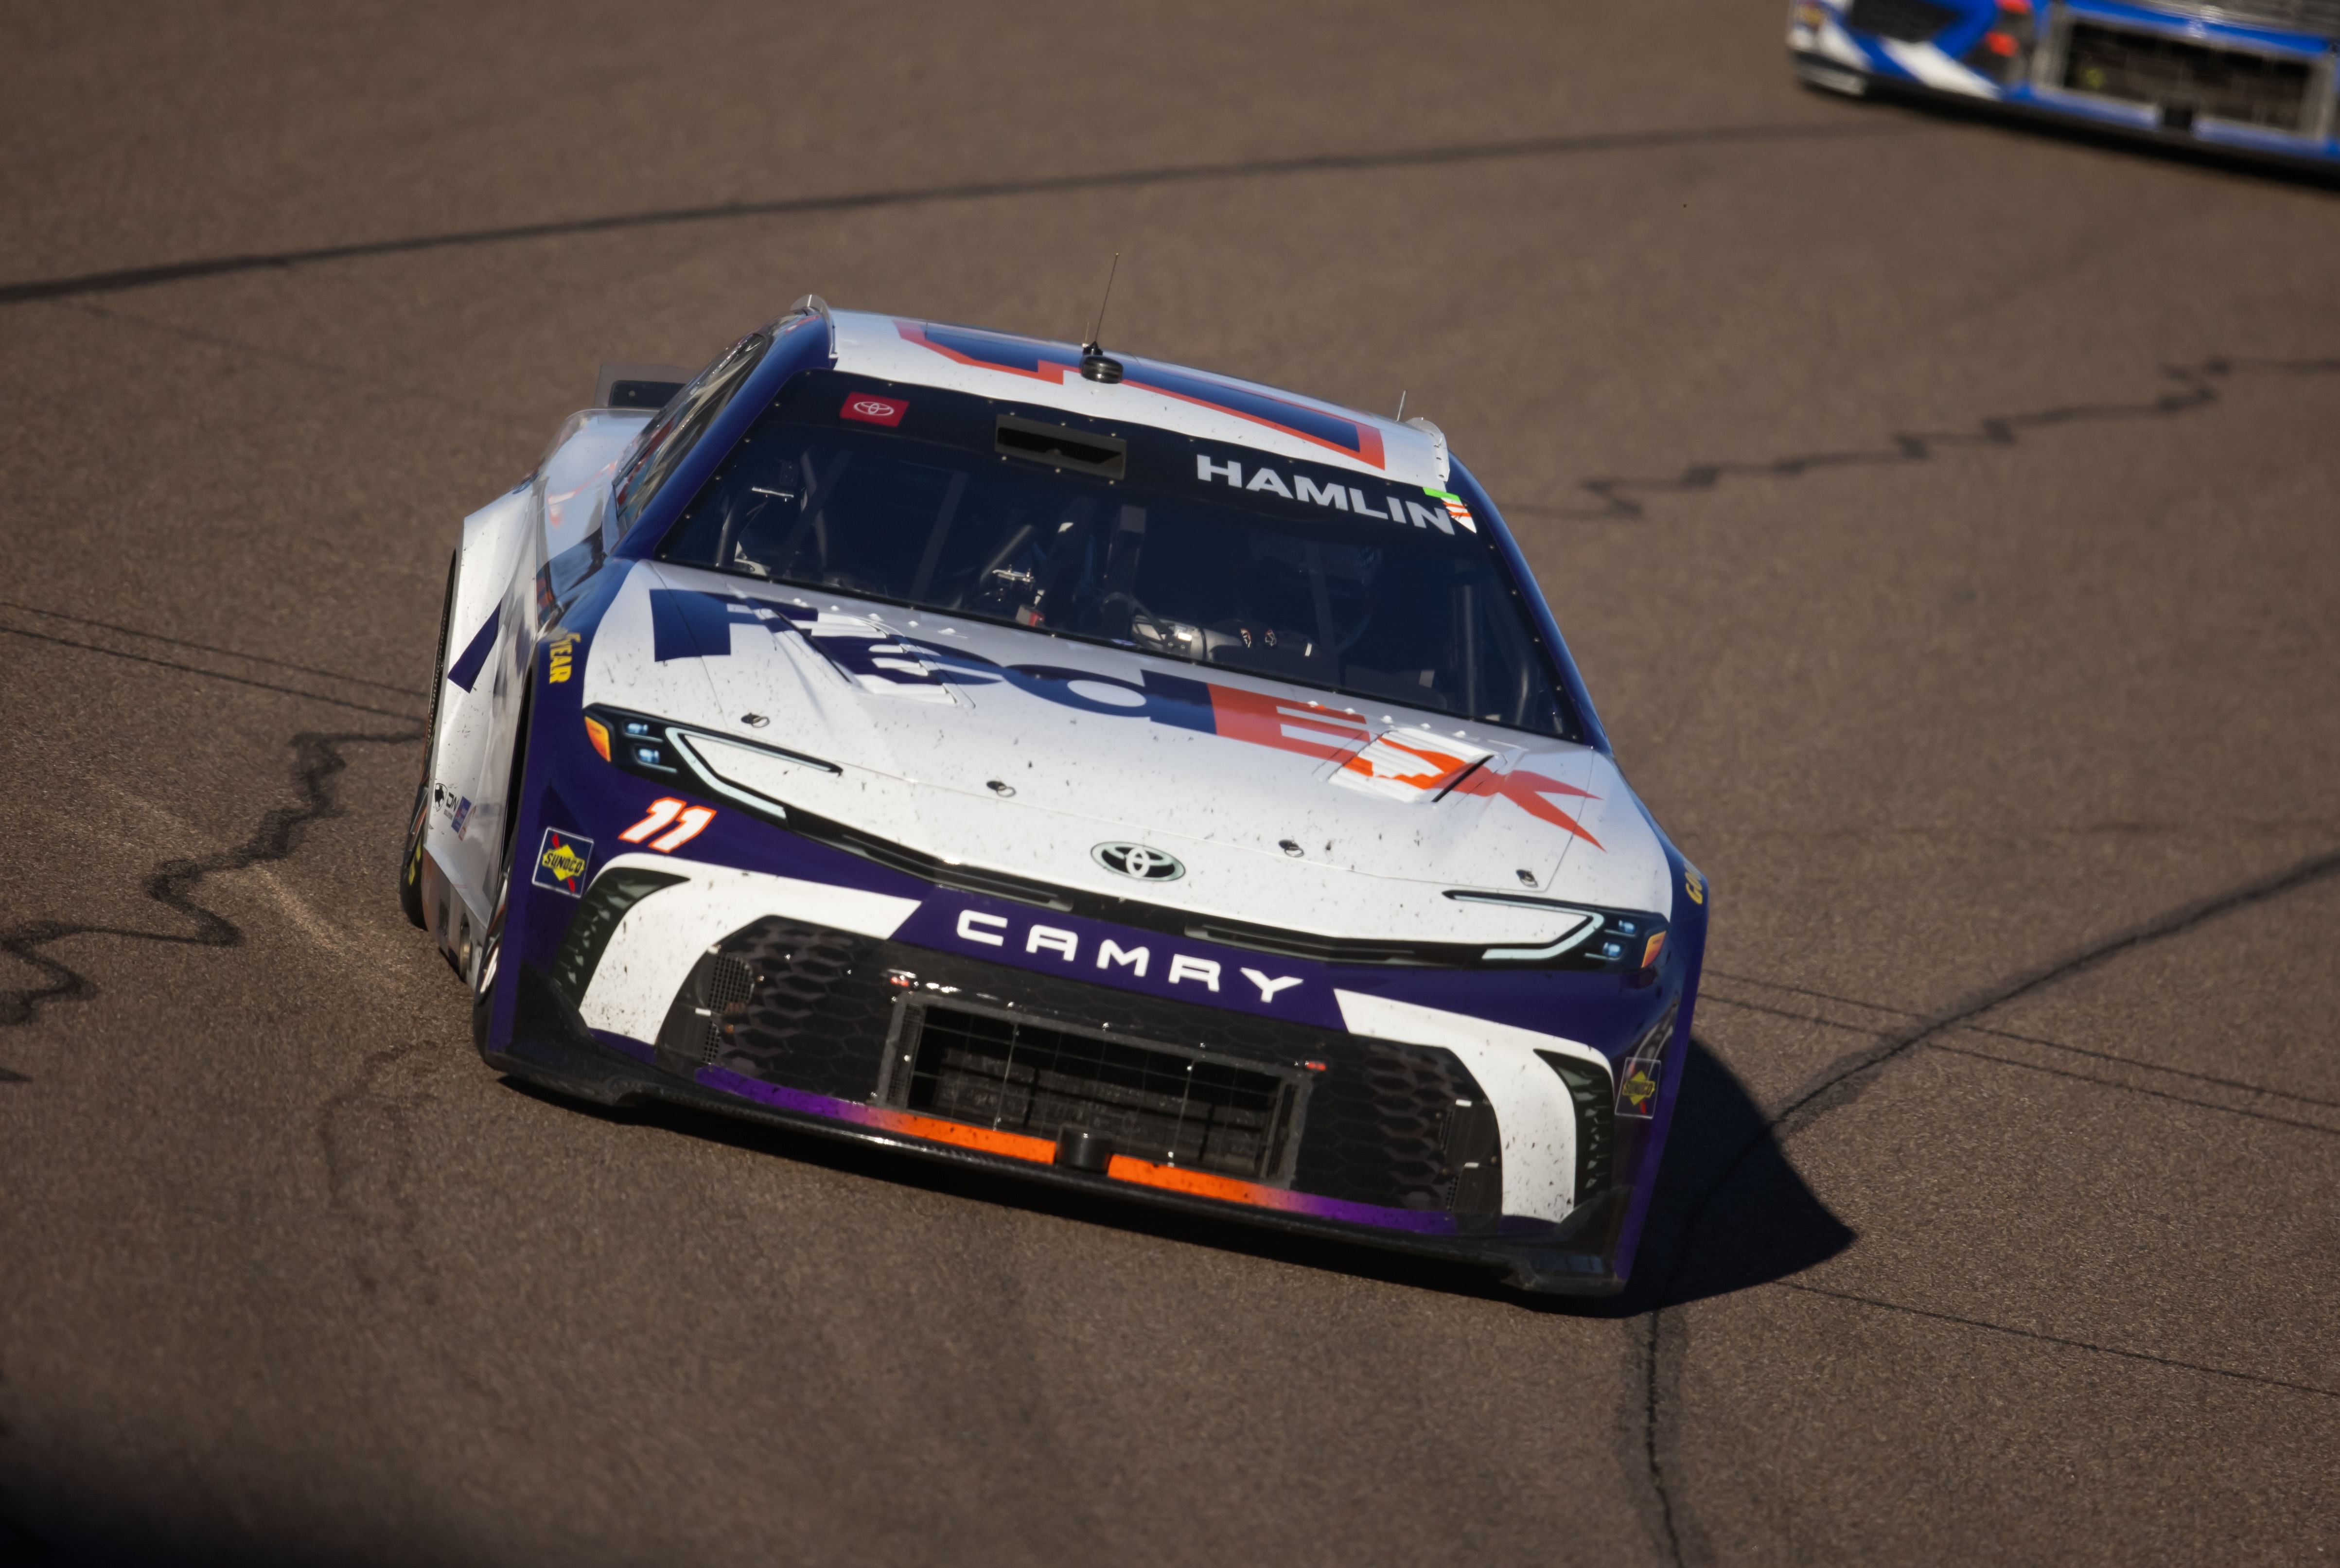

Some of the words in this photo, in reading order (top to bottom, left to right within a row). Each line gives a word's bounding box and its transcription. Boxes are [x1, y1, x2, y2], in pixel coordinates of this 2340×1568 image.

[1196, 454, 1455, 536] HAMLIN
[617, 796, 717, 853] 11
[545, 853, 582, 874] SUNOCO
[957, 909, 1304, 1003] CAMRY
